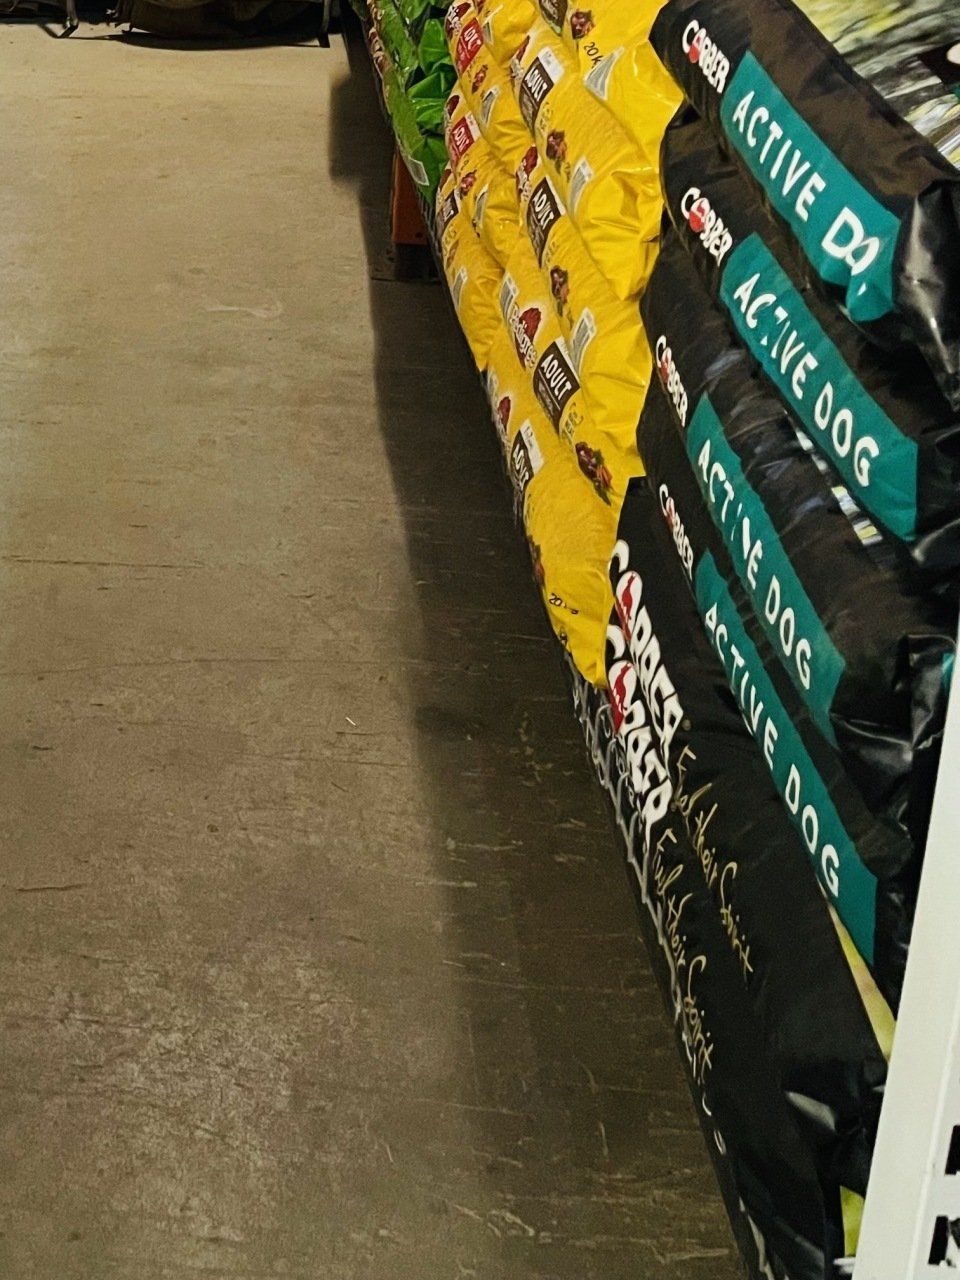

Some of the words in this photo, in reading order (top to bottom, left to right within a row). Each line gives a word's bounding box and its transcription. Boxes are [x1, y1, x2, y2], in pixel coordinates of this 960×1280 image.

[682, 19, 731, 94] COBBER
[681, 186, 732, 268] COBBER
[732, 90, 827, 222] ACTIVE
[540, 353, 573, 401] ADULT
[733, 273, 819, 400] ACTIVE
[814, 381, 880, 488] DOG
[697, 438, 763, 591] ACTIVE
[765, 573, 812, 690] DOG
[608, 538, 684, 773] COBBER
[704, 601, 779, 772] ACTIVE
[785, 763, 841, 900] DOG
